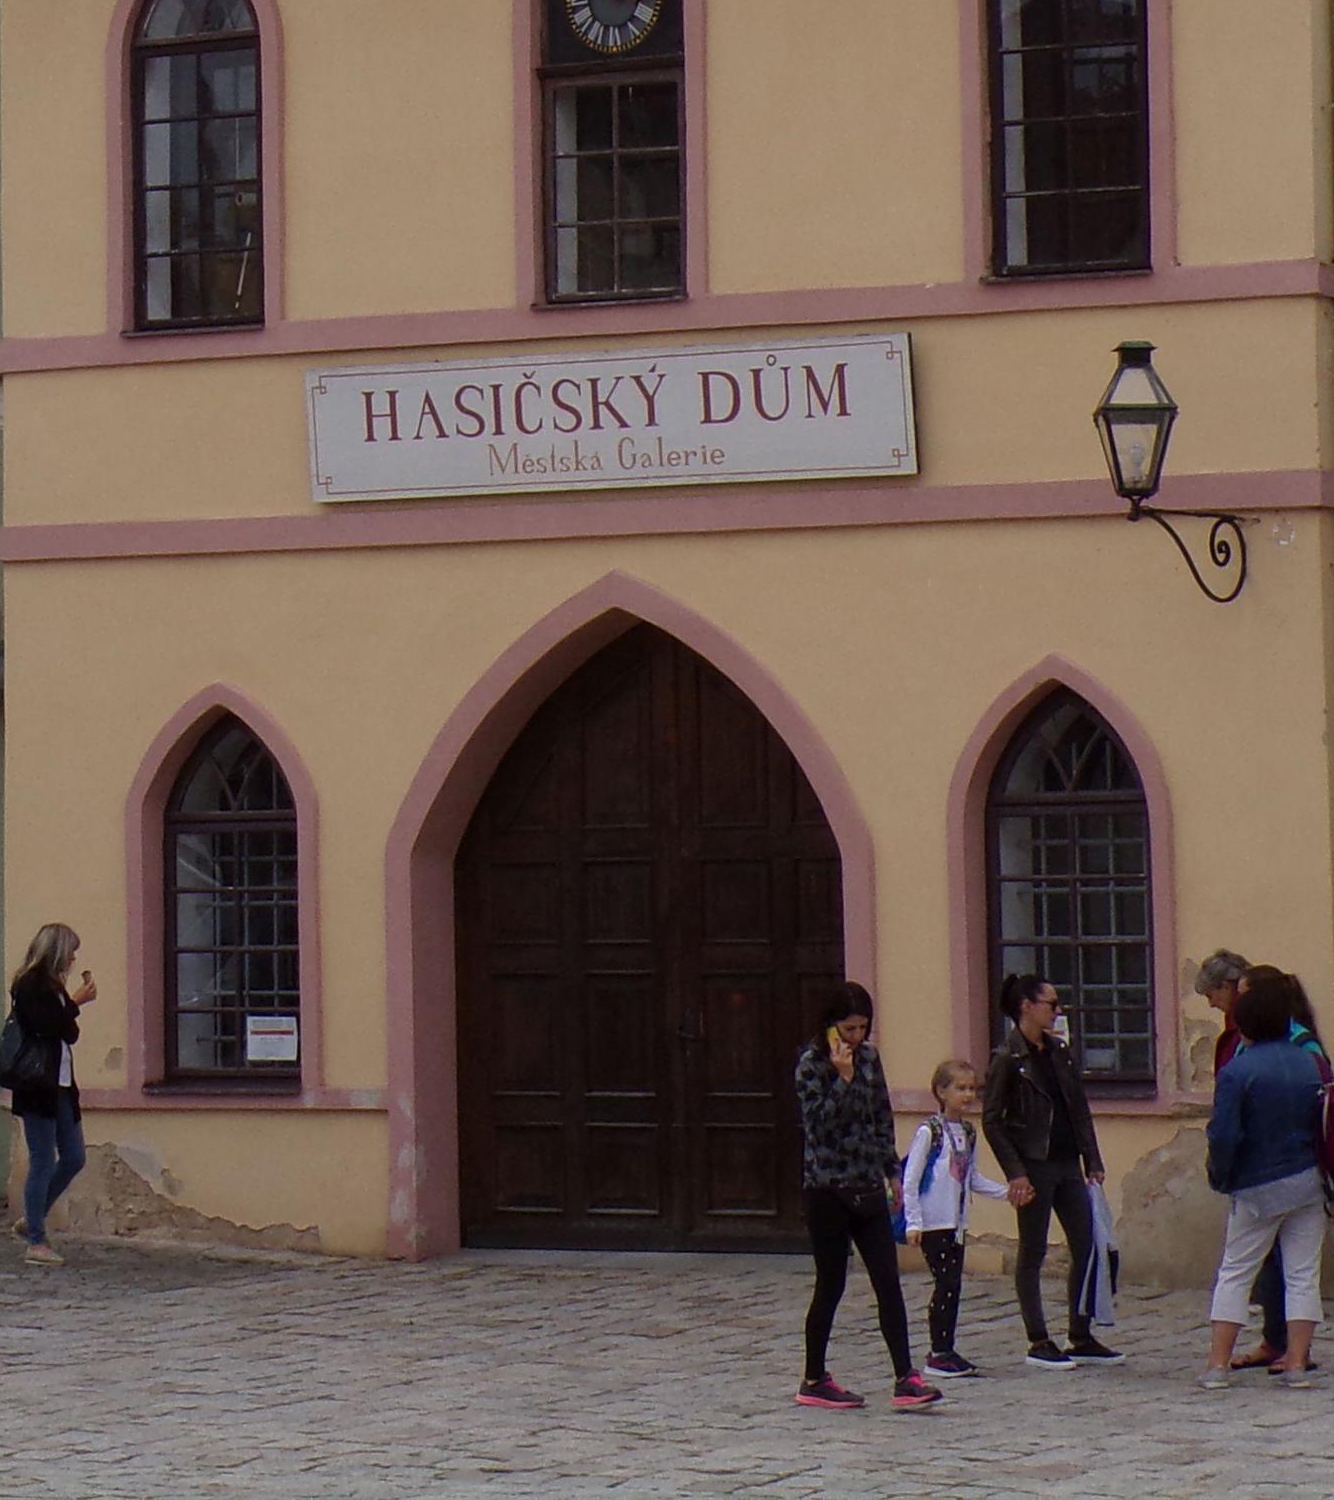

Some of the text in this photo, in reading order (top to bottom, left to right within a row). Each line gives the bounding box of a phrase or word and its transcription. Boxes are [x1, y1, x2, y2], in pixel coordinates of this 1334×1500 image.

[362, 354, 852, 443] HASIČSKÝ DŮM
[617, 436, 727, 470] Galerie
